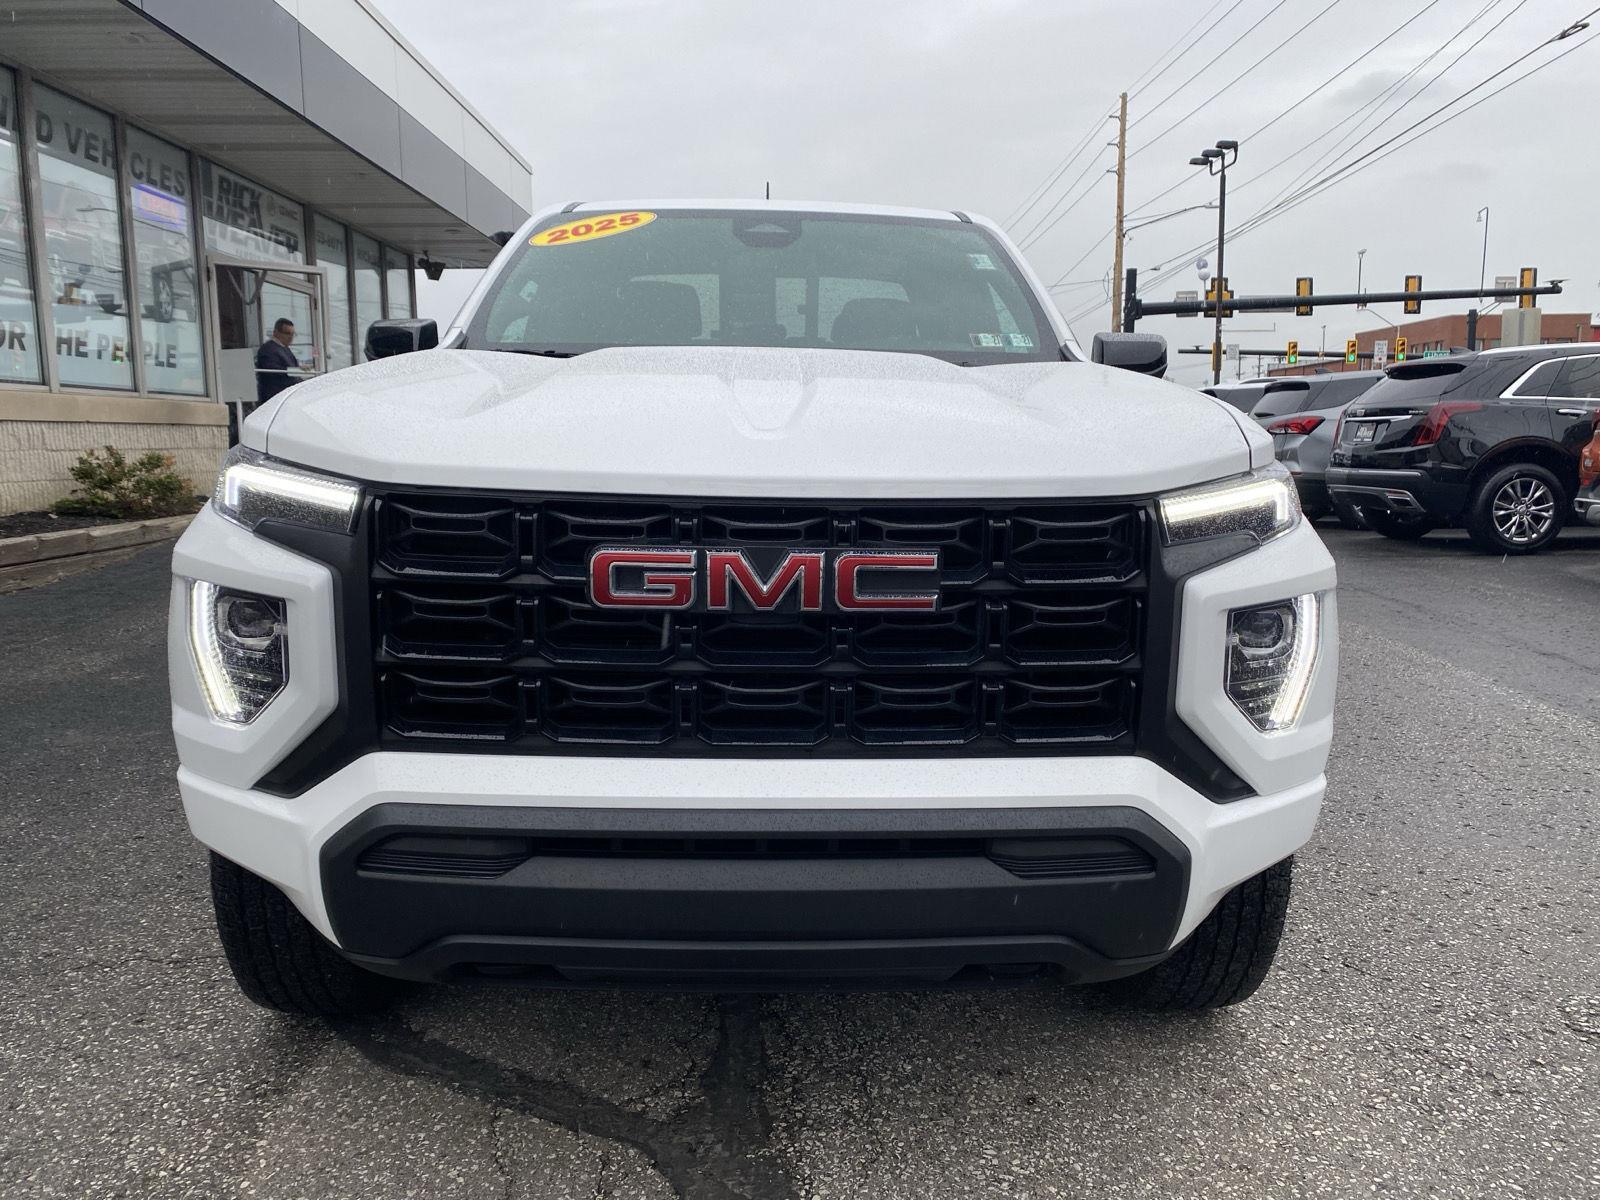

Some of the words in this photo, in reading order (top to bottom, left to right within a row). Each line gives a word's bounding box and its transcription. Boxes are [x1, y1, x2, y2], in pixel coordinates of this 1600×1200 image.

[64, 121, 186, 197] VEHCLES
[217, 174, 263, 213] RICK
[546, 213, 641, 244] 2025
[590, 548, 938, 612] GMC
